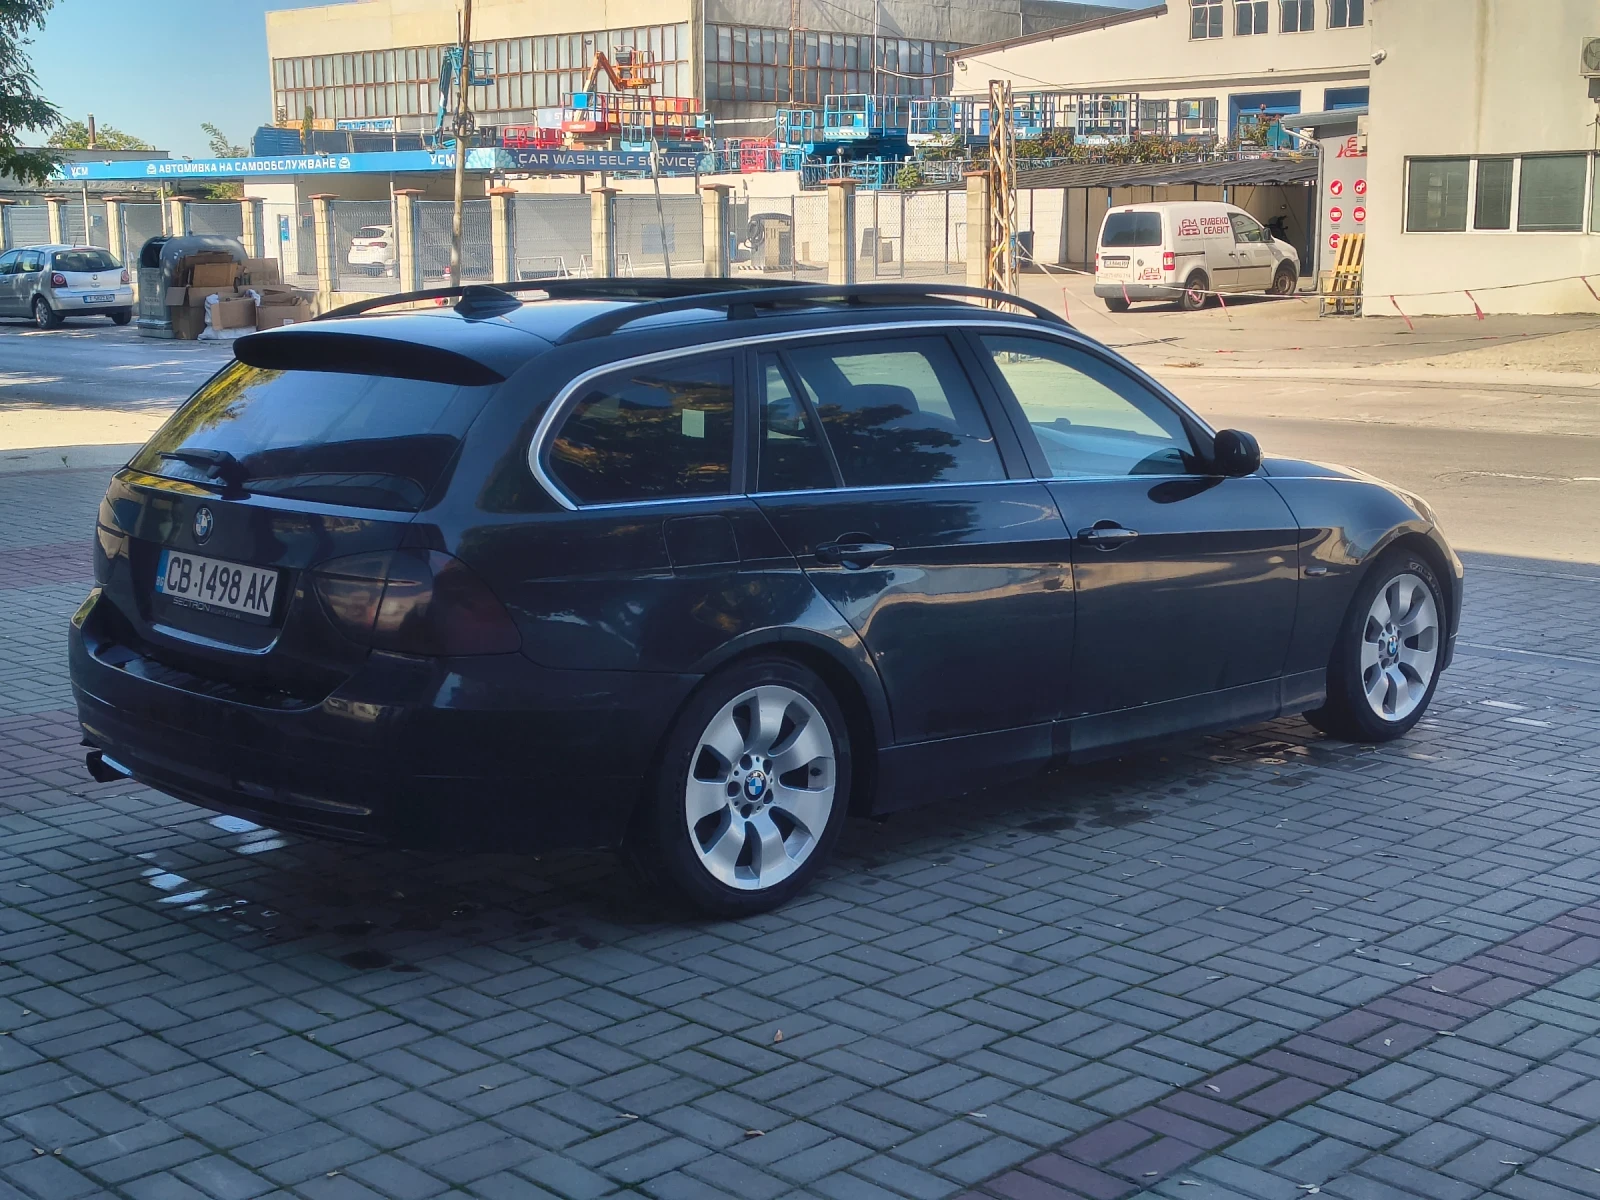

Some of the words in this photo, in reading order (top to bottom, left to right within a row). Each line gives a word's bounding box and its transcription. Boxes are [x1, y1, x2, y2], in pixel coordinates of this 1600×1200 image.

[158, 163, 218, 173] АВТОМИВКА
[219, 162, 231, 172] НА
[234, 158, 337, 172] САМООБСЛУЖВАНЕ
[518, 153, 549, 164] CAR
[553, 154, 595, 165] WASH
[599, 155, 635, 166] SELF
[243, 572, 274, 613] AK
[172, 597, 211, 612] SECTRON
